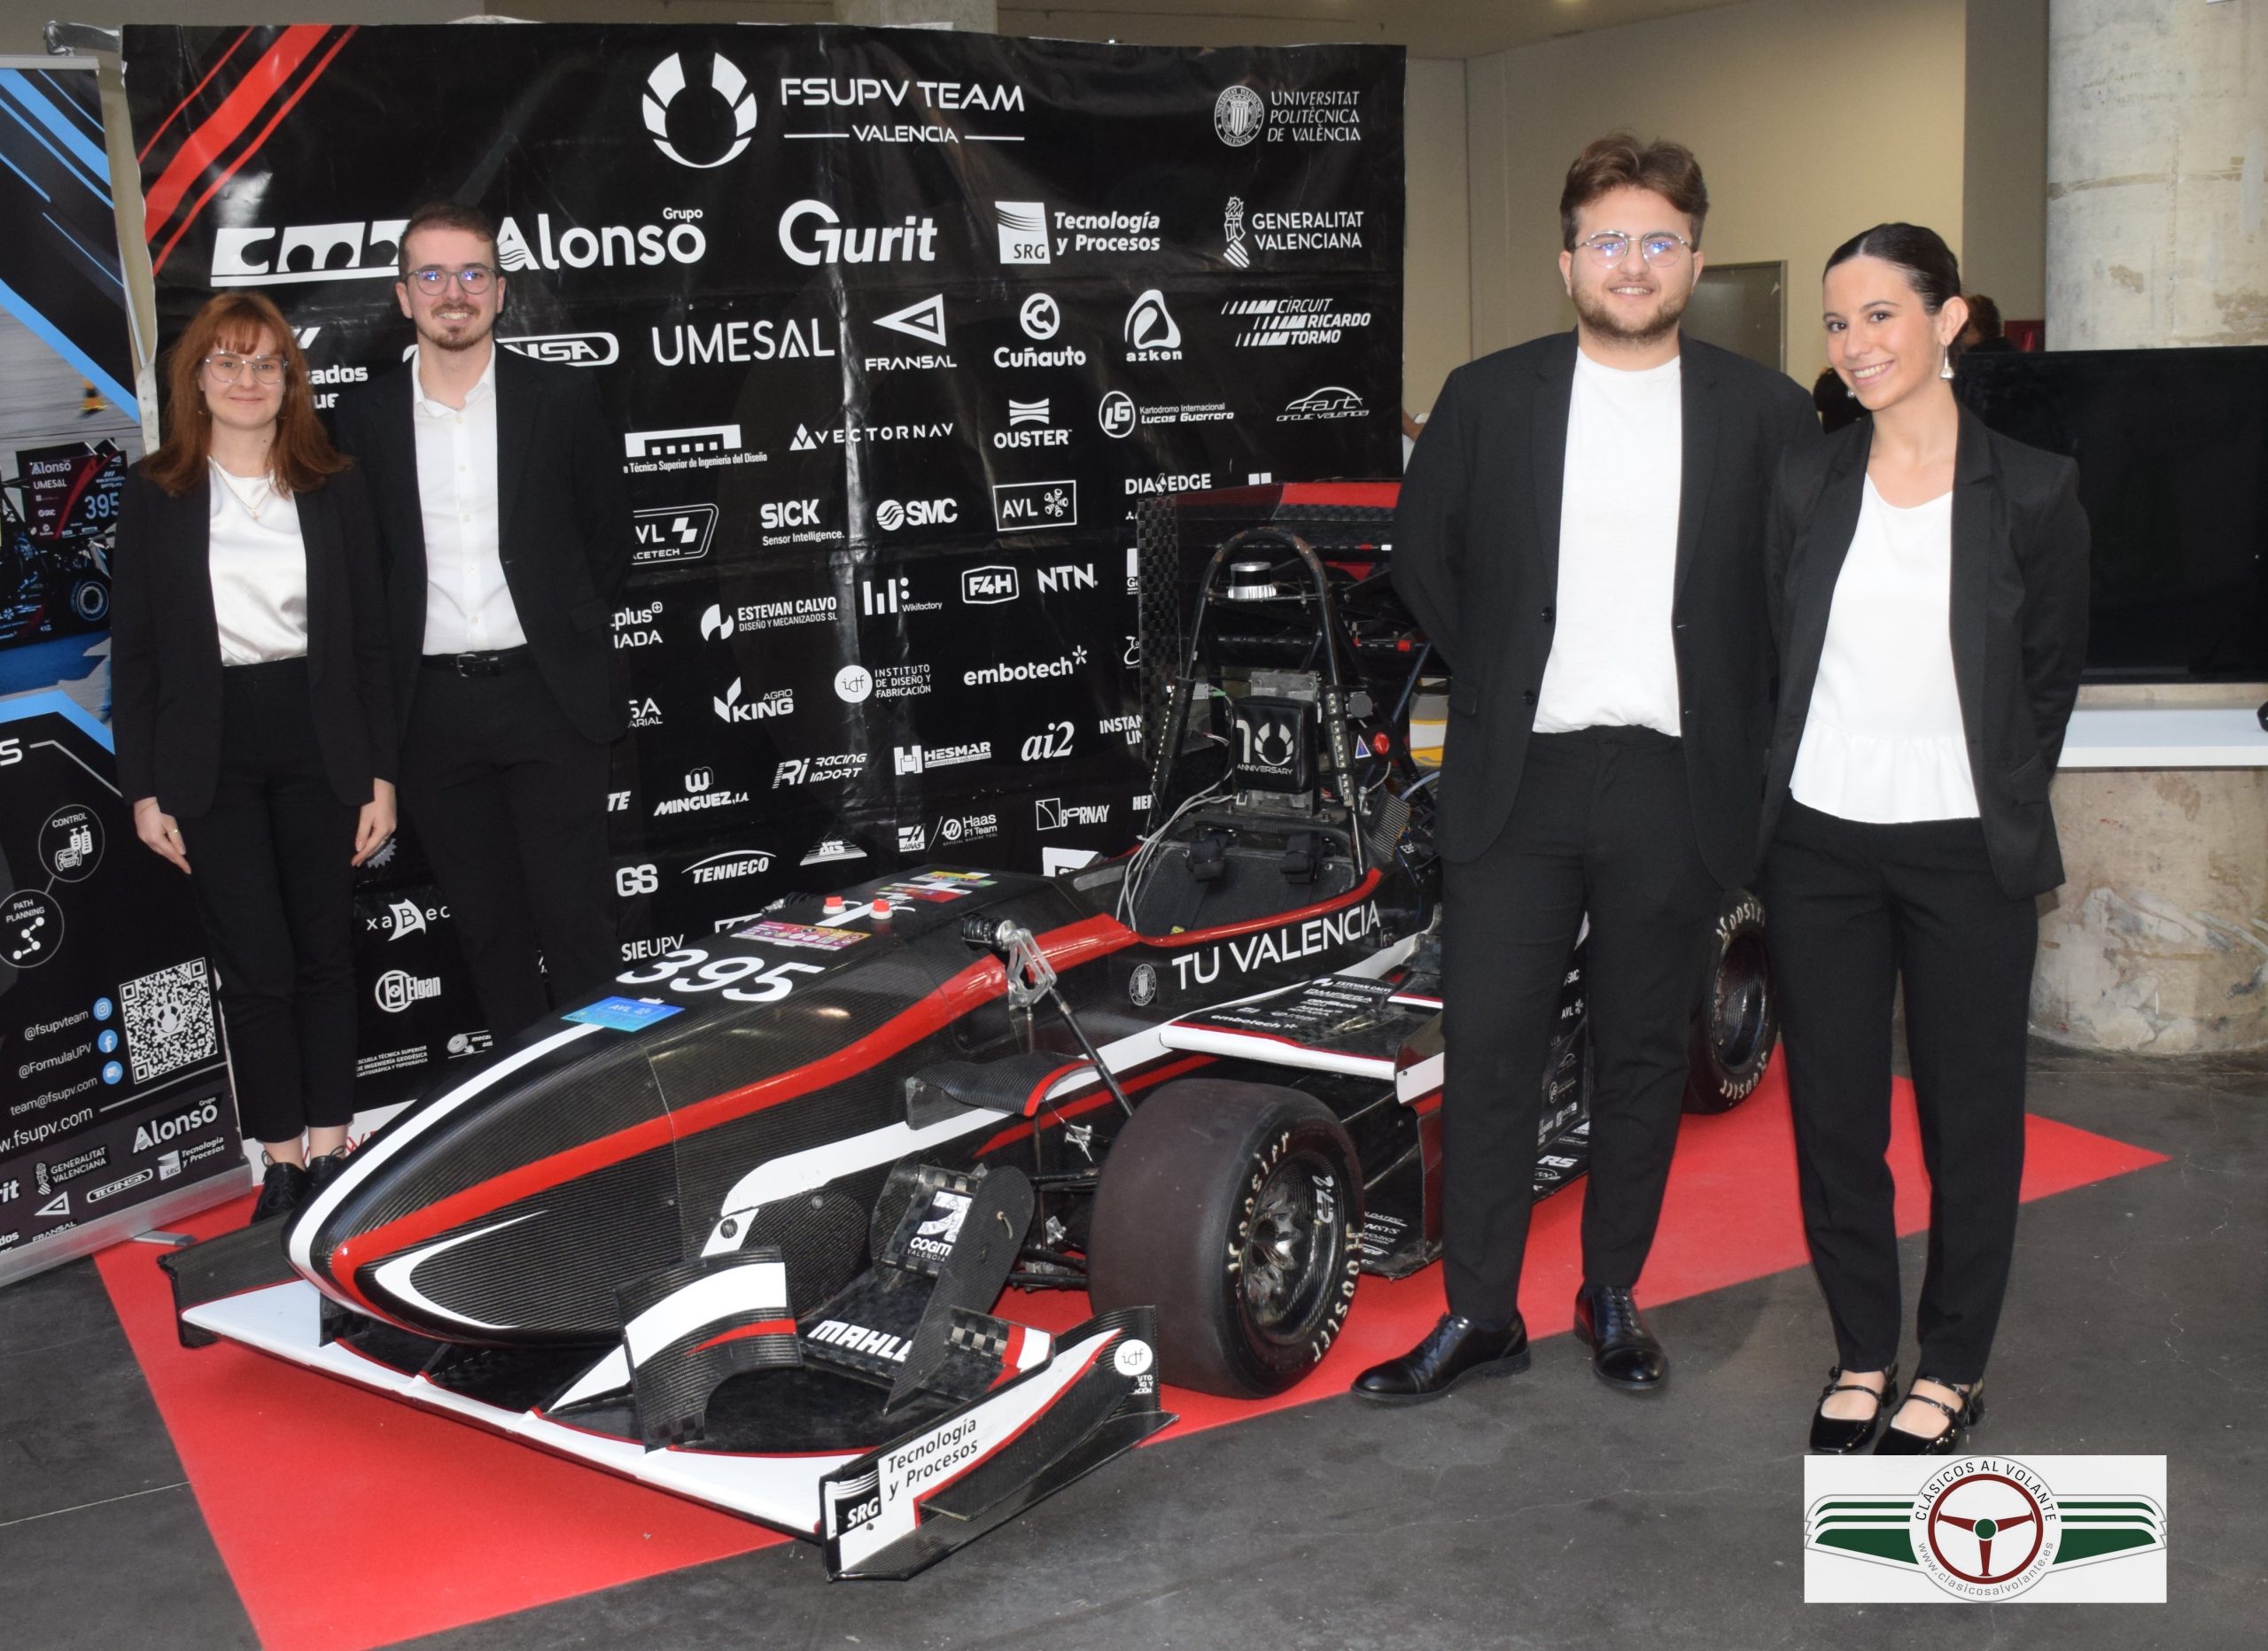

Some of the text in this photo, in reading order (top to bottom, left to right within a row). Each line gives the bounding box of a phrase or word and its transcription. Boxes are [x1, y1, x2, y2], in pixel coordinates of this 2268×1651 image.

[781, 78, 1025, 112] FSUPV TEAM
[1271, 91, 1360, 107] UNIVERSITAT
[1270, 106, 1360, 124] POLITÈCNICA
[851, 125, 959, 143] VALENCIA
[1268, 122, 1361, 143] DE VALÈNCIA
[663, 206, 703, 222] Grupo
[1054, 212, 1161, 231] Tecnología
[1252, 212, 1364, 229] GENERALITAT
[496, 213, 706, 271] Alonso
[779, 199, 937, 266] Gurit
[1255, 233, 1362, 252] VALENCIANA
[1014, 244, 1045, 260] SRG
[1056, 236, 1161, 256] y Procesos
[1278, 296, 1333, 313] CIRCUIT
[1308, 313, 1371, 329] RICARDO
[652, 318, 835, 366] UMESAL
[1291, 329, 1341, 345] TORMO
[866, 355, 957, 371] FRANSAL
[994, 346, 1086, 368] Cuñauto
[1126, 351, 1182, 361] azken
[1139, 402, 1225, 415] Kartodromo Internacional
[1141, 411, 1234, 424] Lucas Guerrero
[815, 422, 954, 444] VECTORNAV
[32, 461, 72, 475] Alonso
[629, 461, 657, 473] Técnica
[658, 459, 687, 472] Superior
[688, 458, 697, 468] de
[698, 453, 732, 469] Ingeniería
[733, 453, 743, 464] del
[744, 452, 768, 462] Diseño
[33, 478, 67, 490] UMESAL
[84, 492, 120, 520] 395
[760, 499, 820, 530] SICK
[906, 498, 959, 526] SMC
[1002, 498, 1038, 518] AVL
[634, 523, 665, 544] VL
[763, 530, 845, 546] Sensor Intelligence.
[633, 548, 680, 561] CETECH
[968, 574, 1012, 596] F4H
[1037, 563, 1095, 593] NTN
[737, 596, 837, 621] ESTEVAN CALVO
[902, 601, 943, 613] Wikifactory
[610, 604, 658, 631] plus
[739, 618, 766, 632] DISEÑO
[767, 618, 772, 628] Y
[773, 614, 827, 628] MECANIZADOS
[614, 630, 664, 648] IADA
[874, 664, 930, 678] INSTITUTO
[875, 673, 932, 688] DE DISEÑO Y
[964, 657, 1074, 686] embotech
[763, 689, 793, 701] AGRO
[875, 684, 931, 699] FABRICACIÓN
[734, 698, 794, 722] KING
[924, 741, 991, 762] HESMAR
[1021, 721, 1075, 762] ai2
[815, 753, 868, 766] RACING
[925, 752, 991, 768] suministros industriales
[1237, 763, 1293, 776] ANNIVERSARY
[810, 767, 863, 783] IMPORT
[607, 791, 632, 812] TE
[51, 812, 88, 828] CONTROL
[962, 814, 997, 829] Haas
[1060, 804, 1109, 827] BORNAY
[975, 826, 998, 835] Team
[616, 864, 659, 896] GS
[693, 857, 769, 884] TENNECO
[5, 906, 45, 923] PLANNING
[13, 899, 34, 911] PATH
[621, 934, 684, 962] SIEUPV
[1171, 946, 1219, 989] TU
[1229, 900, 1381, 973] VALENCIA
[616, 949, 825, 1002] 395
[405, 977, 441, 1001] Elgan
[1210, 1014, 1281, 1028] embotech
[1561, 1006, 1573, 1019] AVL
[24, 1011, 89, 1041] @fsupvteam
[19, 1043, 92, 1079] @FormulaUPV
[358, 1045, 427, 1065] SCUELA TÉCNICA SUPERIOR
[364, 1058, 396, 1070] INGENIERÍA
[396, 1051, 428, 1063] GEODÉSICA
[10, 1077, 98, 1116] team@fsupv.com
[0, 1108, 93, 1152] w.fsupv.com
[133, 1105, 218, 1153] Alonso
[182, 1136, 224, 1158] Tecnología
[190, 1144, 225, 1163] Procesos
[50, 1147, 105, 1174] GENERALITAT
[53, 1158, 106, 1183] VALENCIANA
[166, 1166, 181, 1176] SRG
[0, 1180, 19, 1203] it
[33, 1221, 77, 1242] FRANSAL
[1364, 1222, 1401, 1234] NSYS
[0, 1231, 19, 1246] dos
[907, 1249, 945, 1262] VALENCIA
[888, 1419, 976, 1473] Tecnología
[889, 1439, 978, 1501] y Procesos
[847, 1497, 879, 1529] SRG
